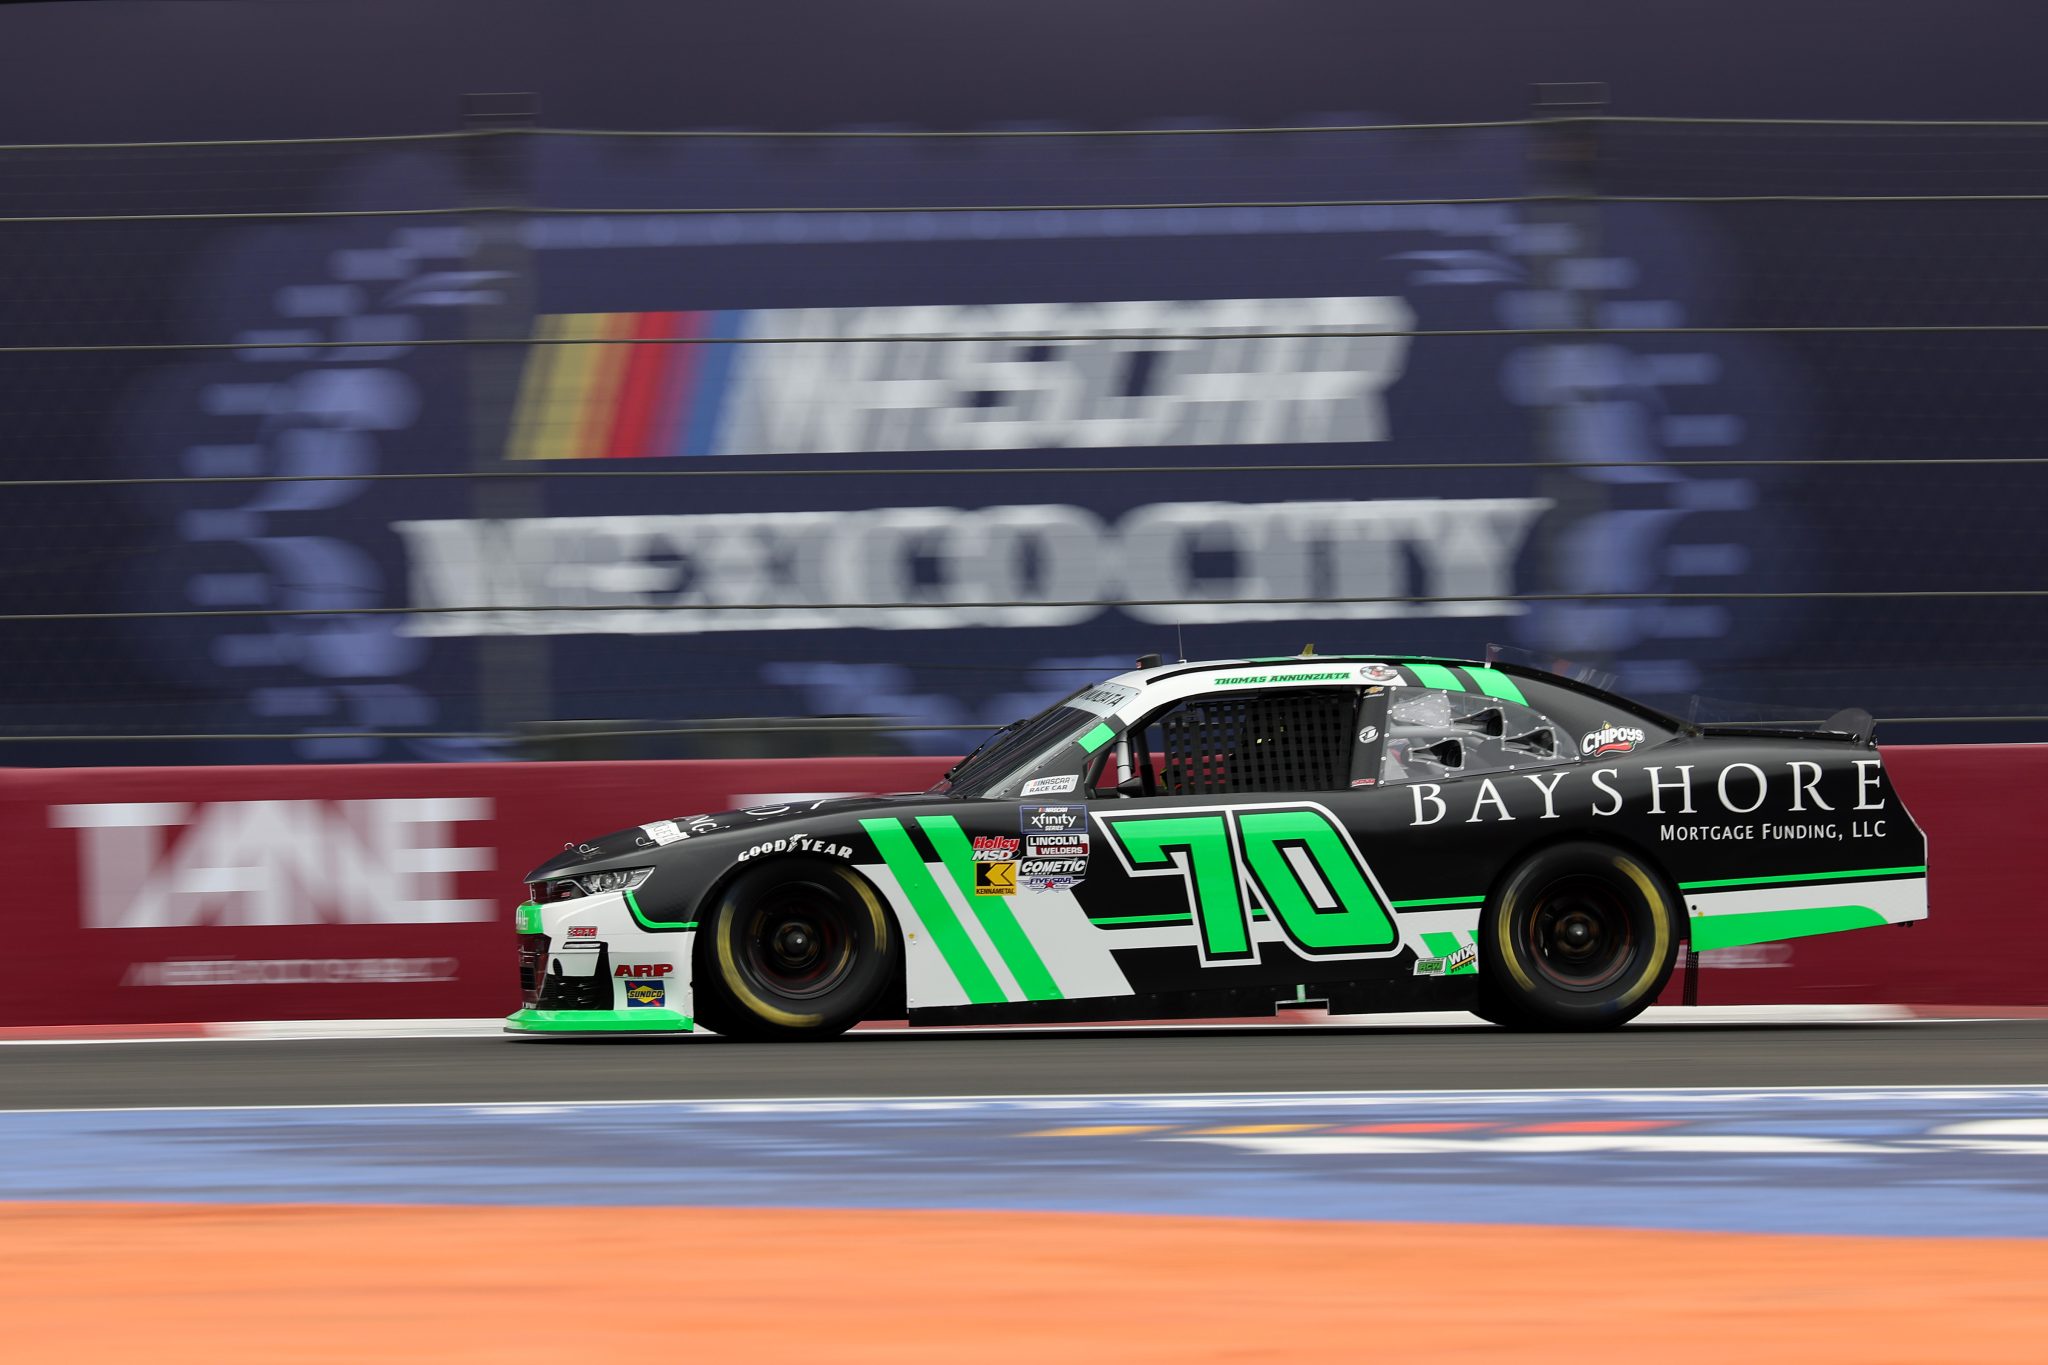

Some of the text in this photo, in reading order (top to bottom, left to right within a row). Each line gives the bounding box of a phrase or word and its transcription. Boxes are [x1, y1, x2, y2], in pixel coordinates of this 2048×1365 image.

[706, 296, 1416, 457] NASCAR
[1214, 672, 1350, 685] THOMAS ANNUNZIATA
[1582, 728, 1644, 753] CHIPOYS
[1036, 777, 1070, 786] NASCAR
[1406, 759, 1887, 826] BAYSHORE
[1031, 812, 1077, 828] xfinity
[1852, 820, 1886, 838] LLC
[973, 836, 1019, 852] Holley
[1029, 836, 1078, 846] LINCOLN
[972, 850, 1013, 861] MSD
[1040, 846, 1083, 855] WELDERS
[1021, 860, 1086, 873] COMETIC
[1091, 802, 1401, 967] 70
[1448, 944, 1475, 966] WIX
[614, 963, 673, 977] ARP
[628, 989, 663, 999] SUNOCO
